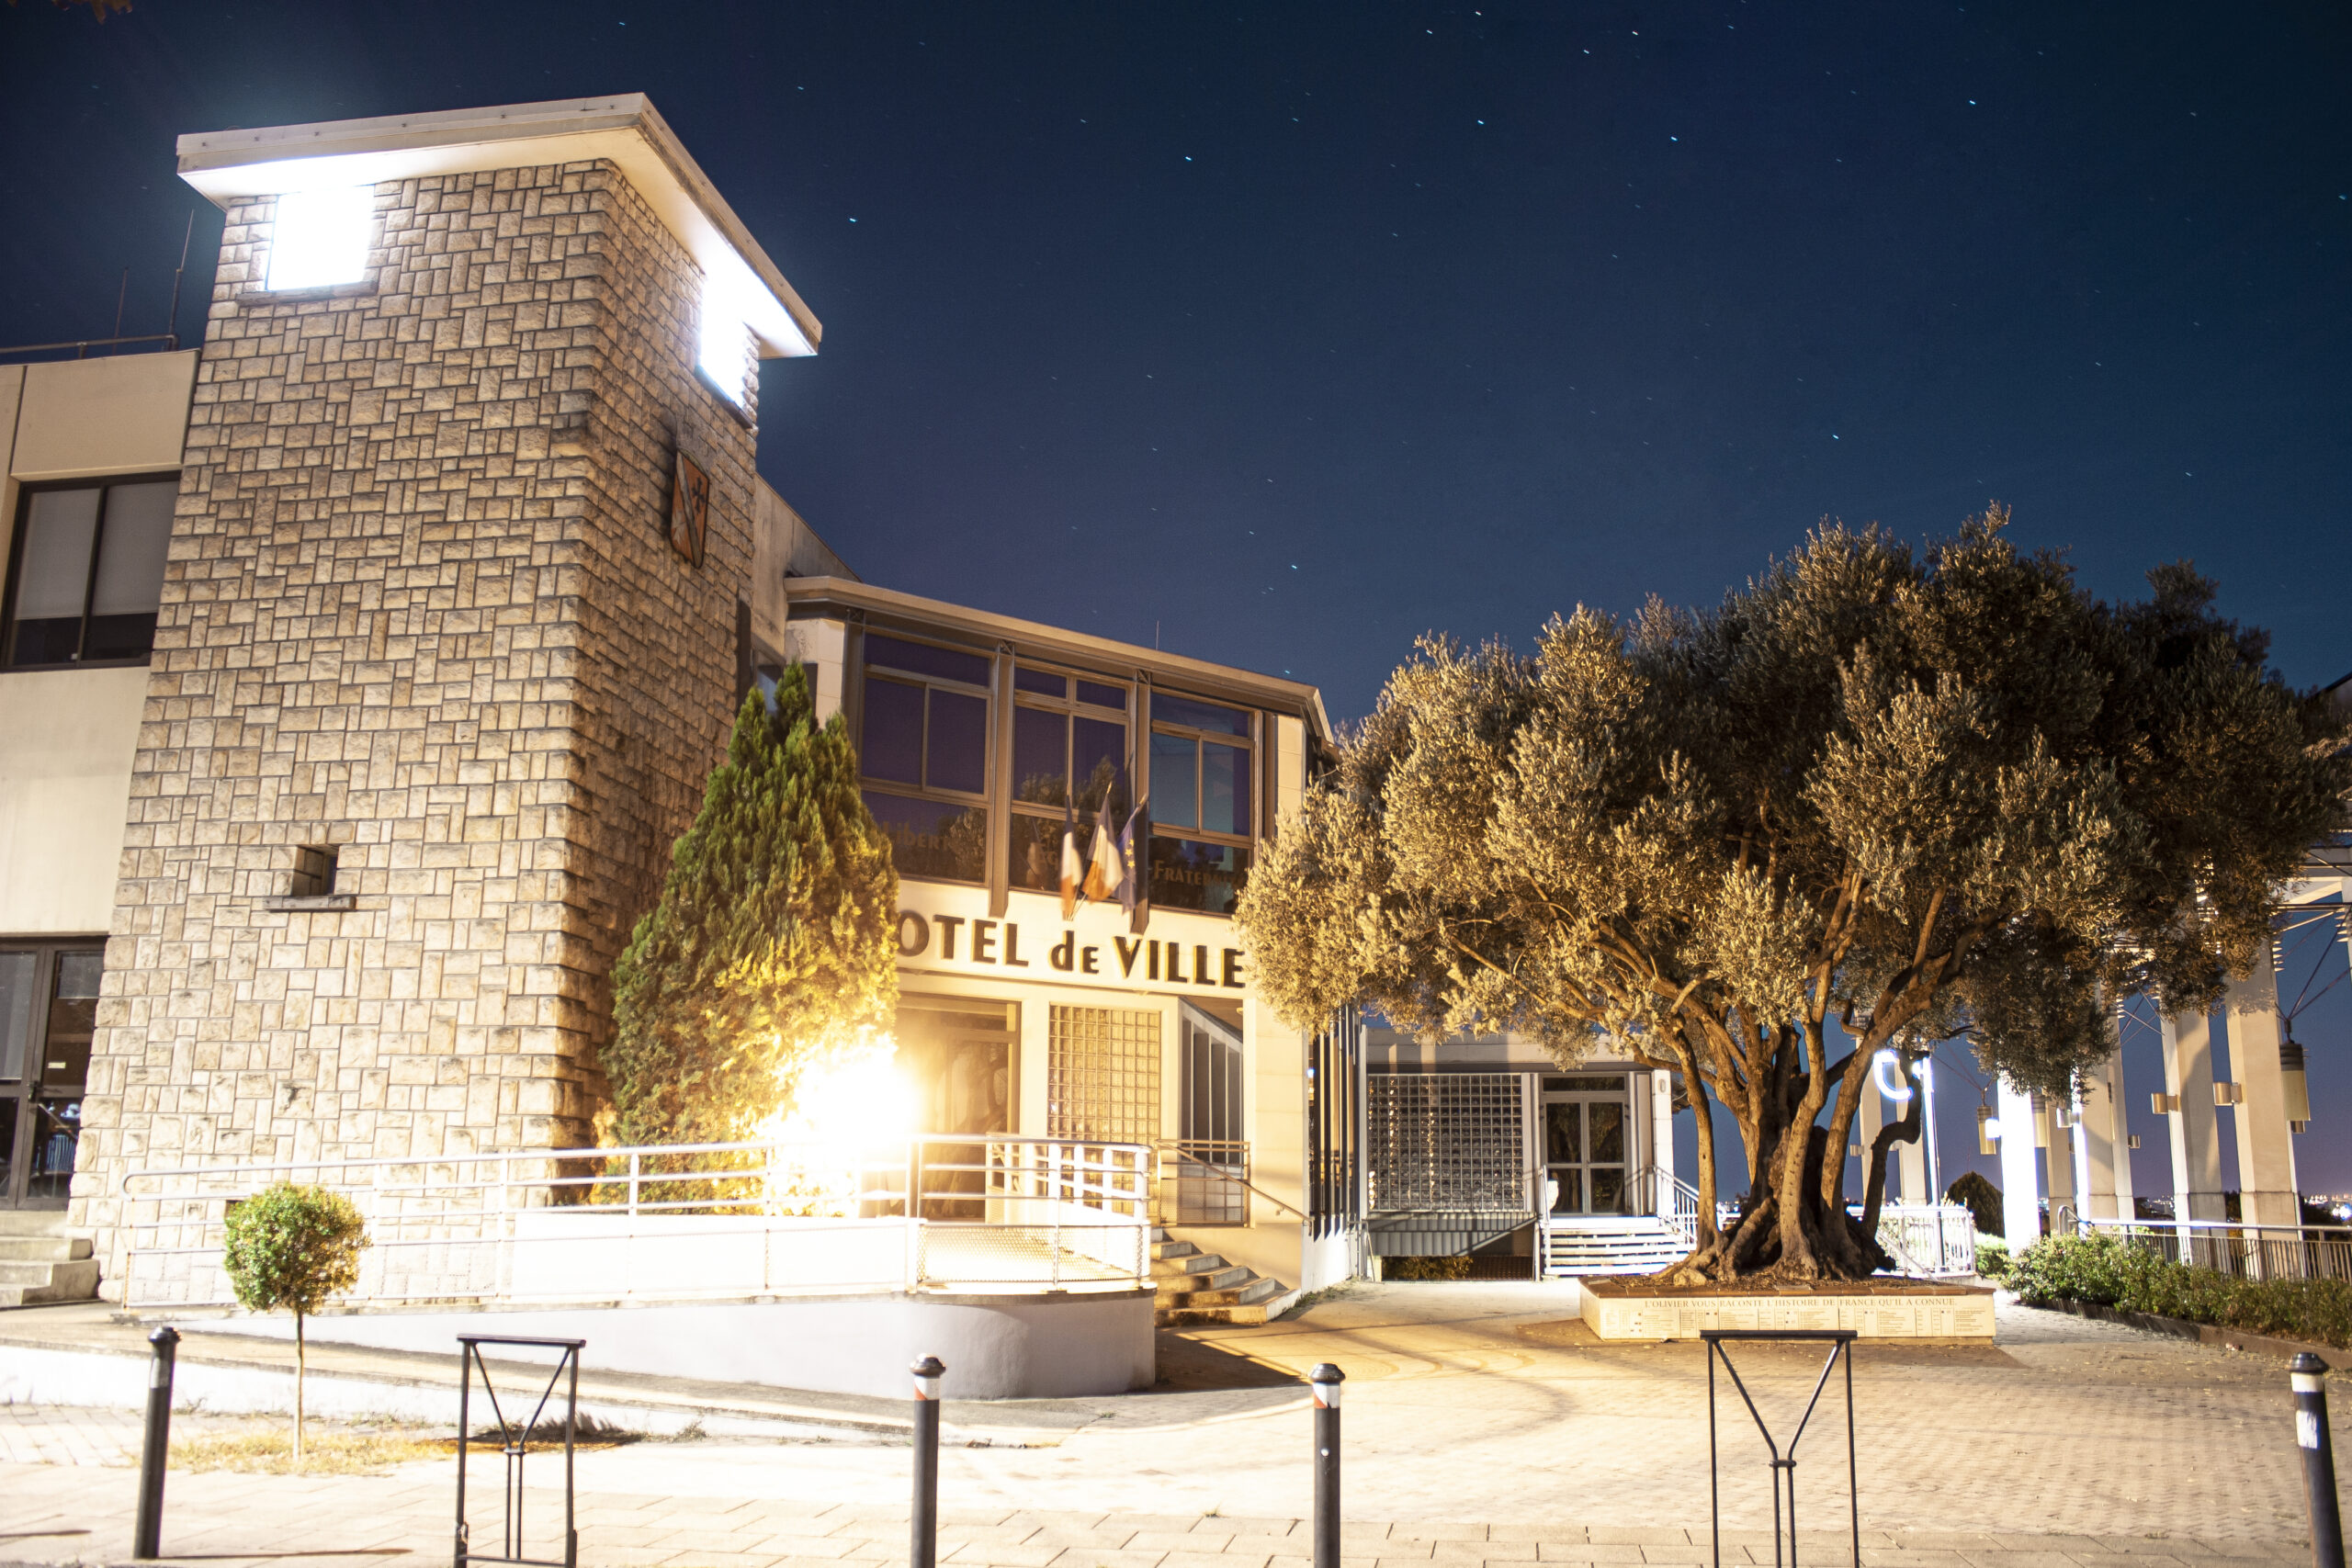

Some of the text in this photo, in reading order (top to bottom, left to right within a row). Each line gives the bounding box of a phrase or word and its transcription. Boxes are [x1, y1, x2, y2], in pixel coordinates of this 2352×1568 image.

[1154, 860, 1244, 889] FRATERNI
[895, 910, 1028, 967] OTEL
[1113, 936, 1246, 987] VILLE
[1645, 1300, 1689, 1308] L'OLIVIER
[1691, 1300, 1716, 1308] VOUS
[1719, 1299, 1761, 1307] RACONTE
[1767, 1299, 1817, 1307] L'HISTOIRE
[1839, 1298, 1876, 1306] FRANCE
[1878, 1298, 1904, 1306] QU'IL
